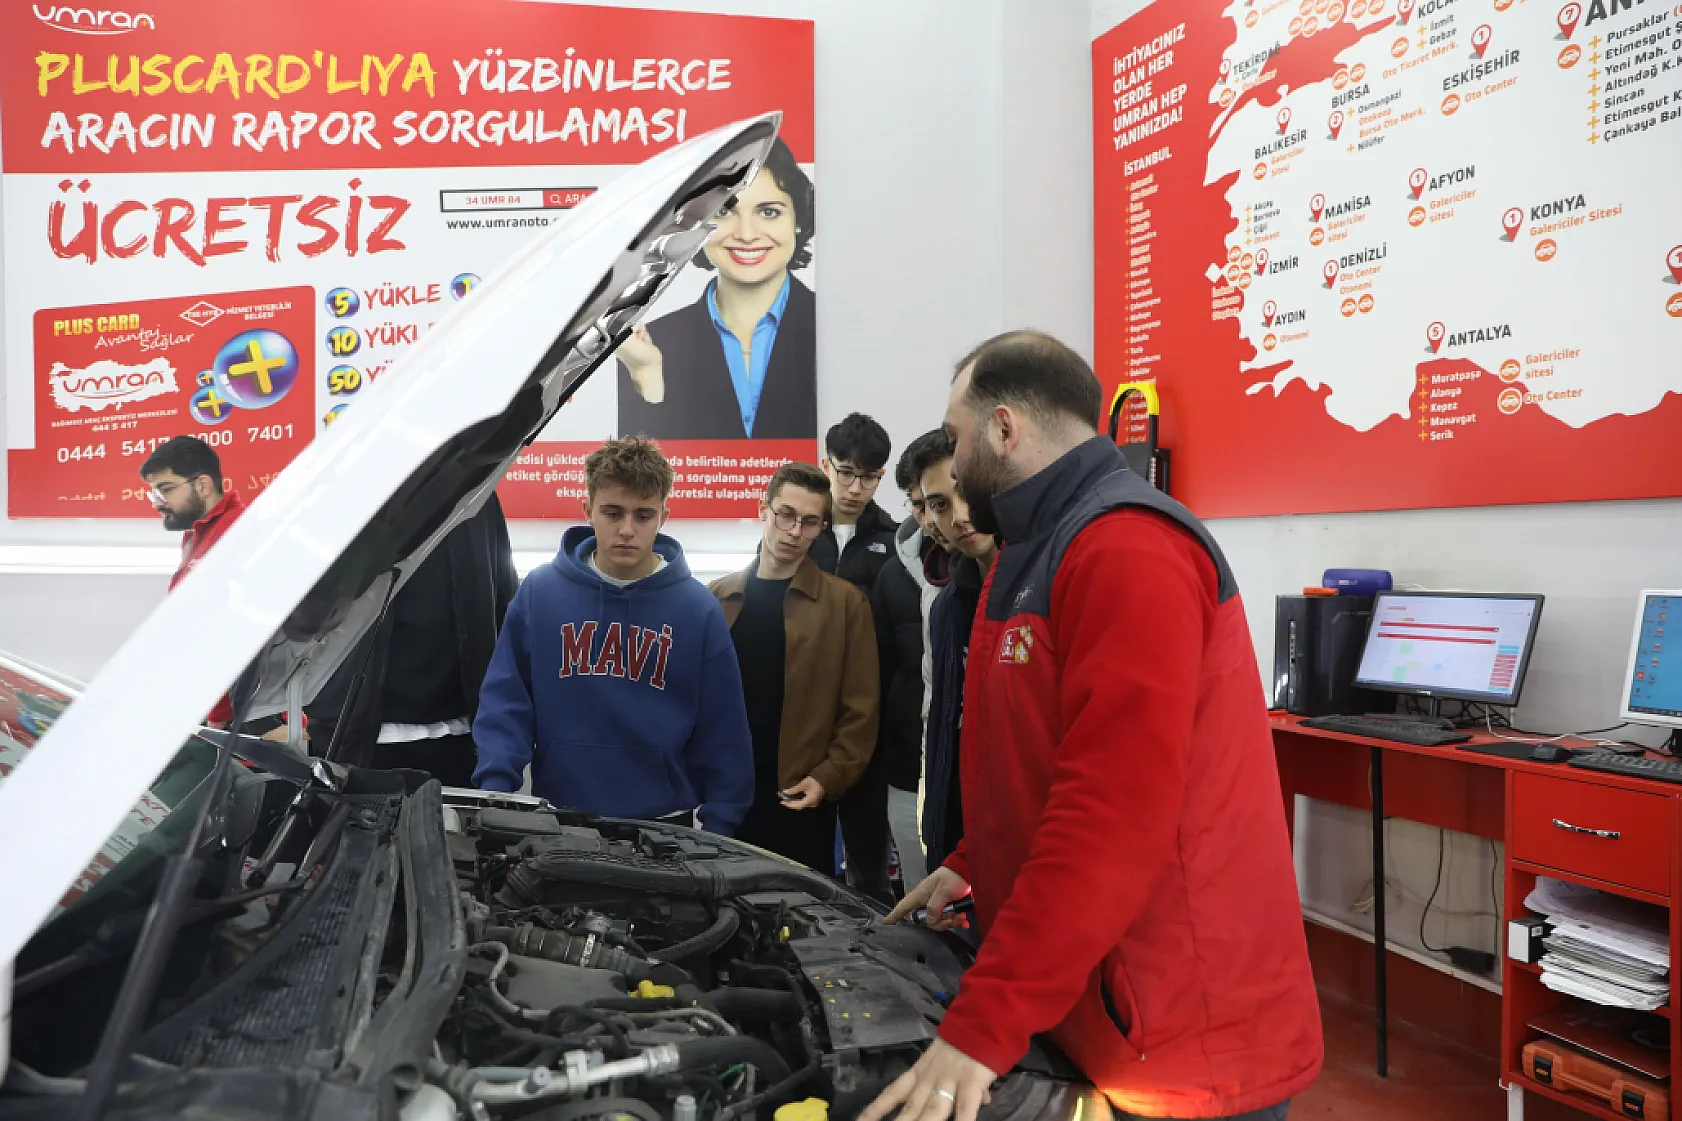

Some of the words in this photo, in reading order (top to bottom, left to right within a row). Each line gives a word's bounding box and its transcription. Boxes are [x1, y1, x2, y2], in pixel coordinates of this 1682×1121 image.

[32, 4, 155, 30] umran
[1607, 11, 1669, 43] Pursaklar
[1113, 23, 1185, 76] İHTİYACINIZ
[1605, 27, 1671, 60] Etimesgut
[35, 50, 438, 99] PLUSCARD'LIYA
[452, 47, 732, 95] YÜZBİNLERCE
[1113, 65, 1145, 94] OLAN
[1149, 51, 1174, 75] HER
[1382, 68, 1397, 79] Oto
[1442, 49, 1520, 92] ESKİŞEHİR
[1605, 57, 1630, 75] Yeni
[1635, 47, 1667, 65] Mah.
[1464, 90, 1481, 102] Oto
[1484, 76, 1518, 95] Center
[1605, 64, 1658, 93] Altındağ
[1113, 81, 1152, 113] YERDE
[1113, 98, 1157, 132] UMRAN
[1161, 83, 1187, 109] HEP
[1331, 83, 1370, 109] BURSA
[1604, 88, 1645, 109] Sincan
[1604, 95, 1670, 125] Etimesgut
[41, 111, 216, 154] ARACIN
[232, 110, 382, 152] RAPOR
[393, 107, 688, 147] SORGULAMASI
[1113, 106, 1183, 151] YANINIZDA!
[1604, 117, 1656, 142] Çankaya
[1255, 128, 1307, 159] BALIKESİR
[1124, 146, 1172, 177] İSTANBUL
[1428, 165, 1475, 191] AFYON
[481, 195, 505, 205] UMR
[1325, 195, 1372, 219] MANİSA
[1429, 188, 1477, 210] Galericiler
[1530, 194, 1586, 221] KONYA
[48, 178, 411, 267] ÜCRETSİZ
[446, 217, 558, 230] www.umranoto.
[1529, 213, 1586, 237] Galericiler
[1588, 203, 1623, 222] Sitesi
[1269, 255, 1299, 275] İZMİR
[1340, 242, 1387, 269] DENİZLİ
[334, 291, 350, 316] 5
[364, 282, 441, 310] YÜKLE
[53, 317, 93, 336] PLUS
[97, 314, 140, 333] CARD
[1275, 309, 1306, 326] AYDIN
[95, 323, 161, 349] Avantaj
[140, 333, 195, 352] Sağlar
[331, 331, 357, 355] 10
[1448, 324, 1513, 347] ANTALYA
[1525, 348, 1581, 365] Galericiler
[62, 370, 164, 393] umran
[329, 369, 361, 392] 50
[1431, 369, 1482, 385] Muratpaşa
[1430, 386, 1462, 399] Alanya
[1523, 391, 1544, 405] Oto
[1546, 388, 1583, 402] Center
[1430, 401, 1459, 414] Kepez
[1430, 413, 1477, 427] Manavgat
[57, 444, 106, 463] 0444
[188, 430, 233, 447] 000
[247, 423, 293, 442] 7401
[1430, 429, 1454, 441] Serik
[513, 453, 543, 465] edisi
[686, 455, 737, 467] belirtilen
[506, 469, 541, 481] etiket
[544, 470, 586, 484] gördüğ
[687, 472, 745, 484] sorgulama
